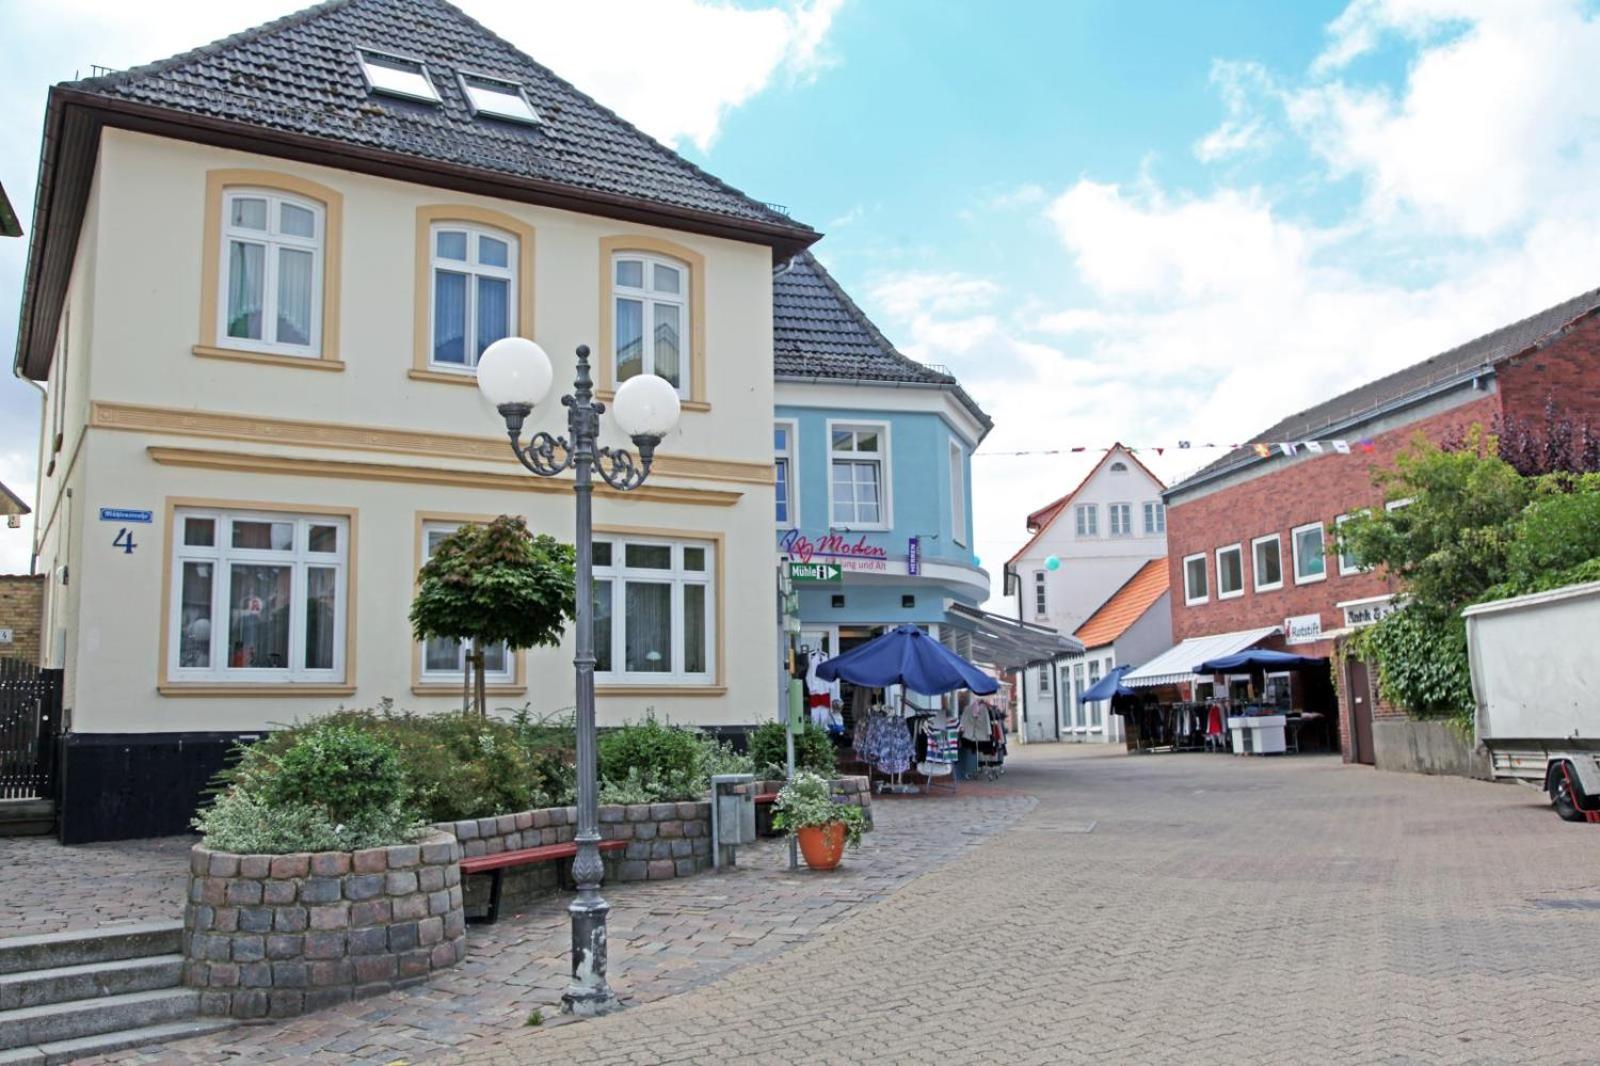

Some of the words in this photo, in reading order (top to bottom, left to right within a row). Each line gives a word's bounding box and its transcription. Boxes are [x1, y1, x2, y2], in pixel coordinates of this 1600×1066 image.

[112, 527, 138, 554] 4
[816, 535, 887, 556] Moden
[792, 564, 817, 577] Mühle
